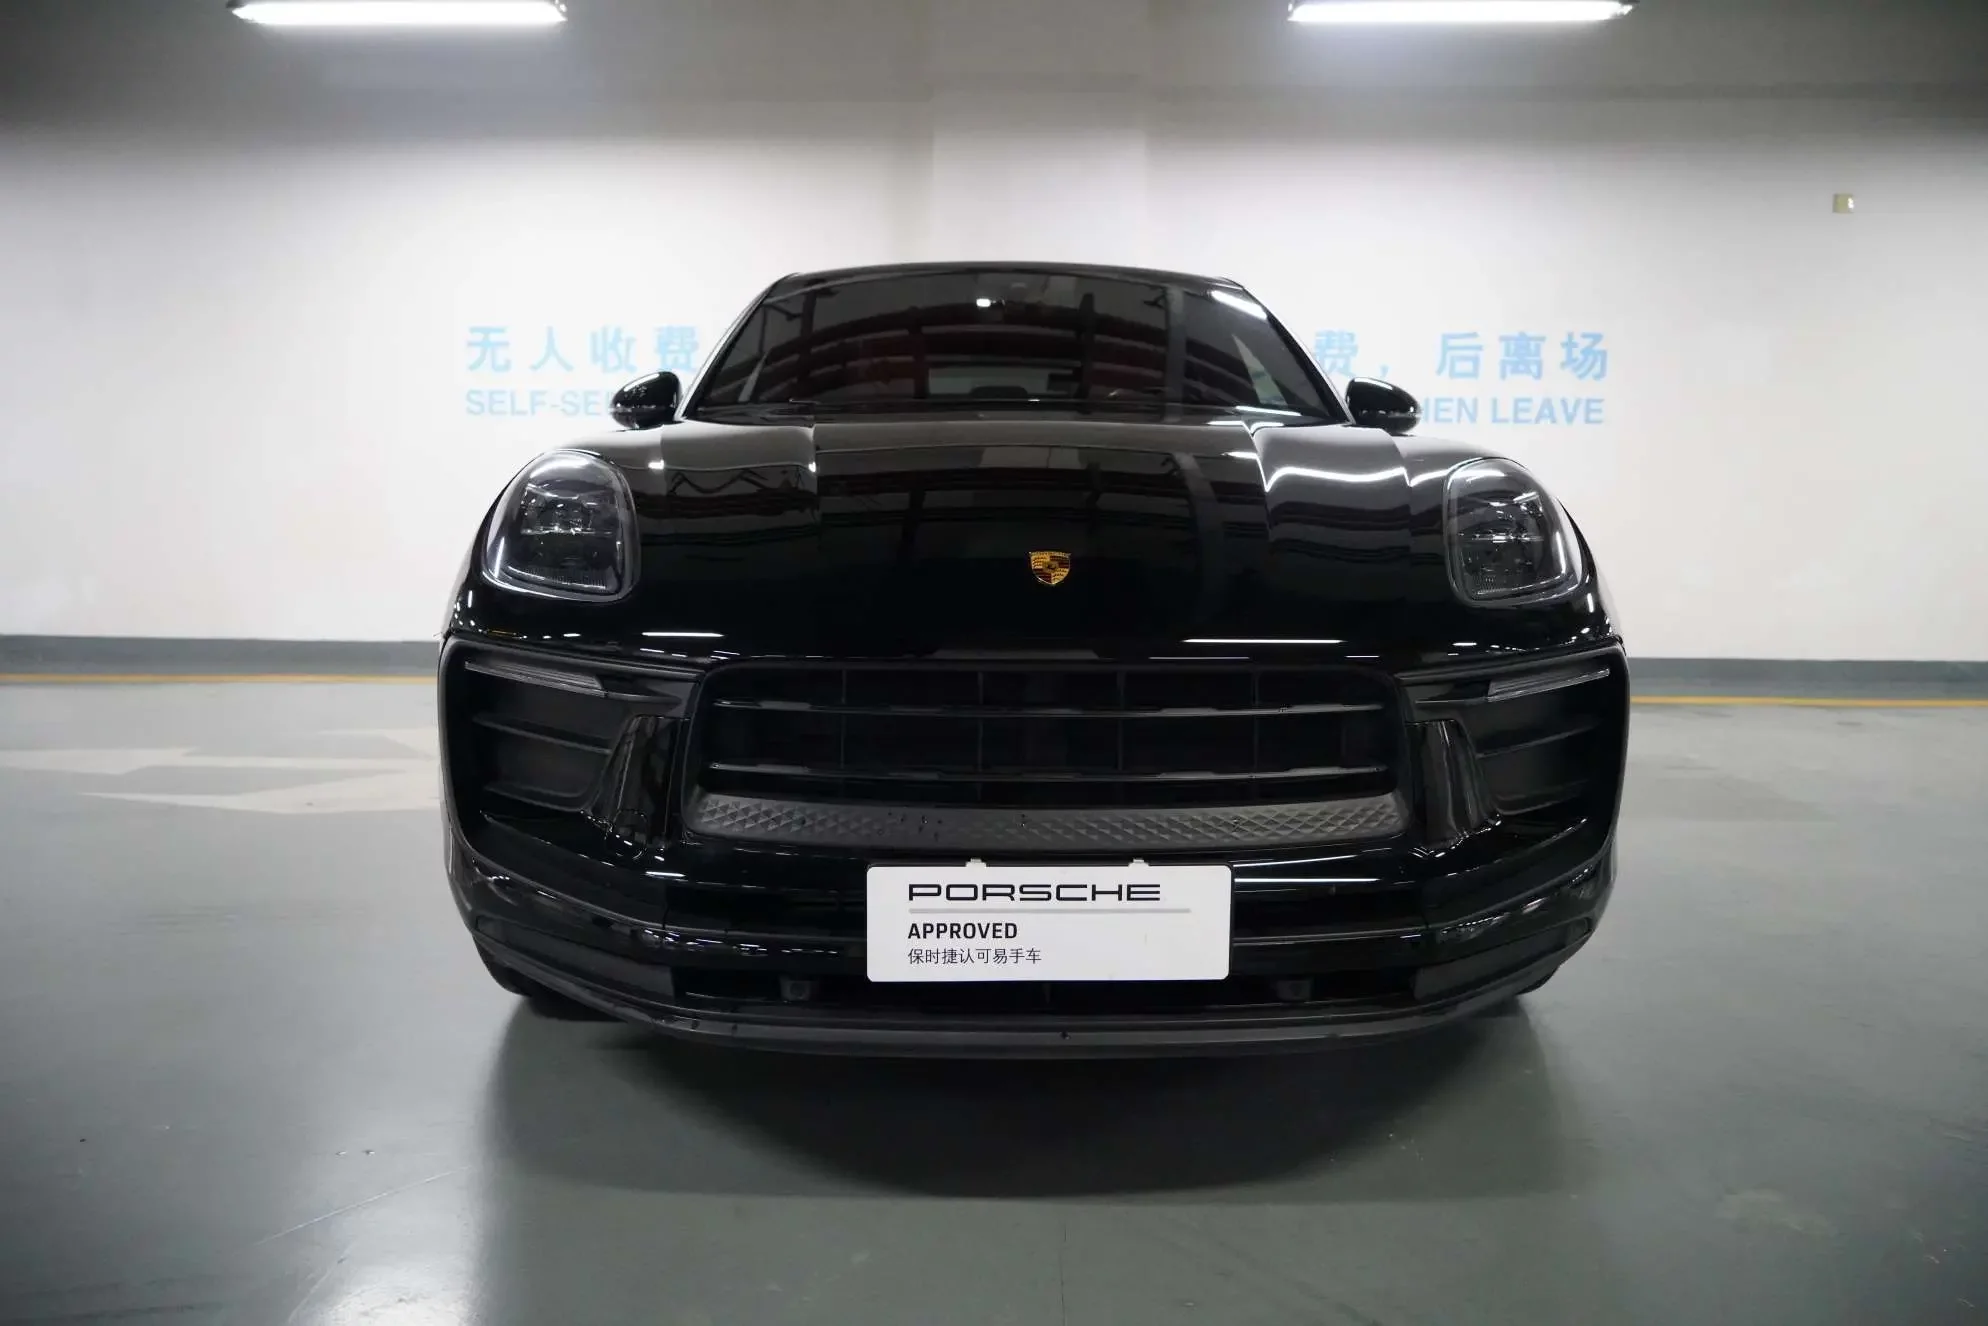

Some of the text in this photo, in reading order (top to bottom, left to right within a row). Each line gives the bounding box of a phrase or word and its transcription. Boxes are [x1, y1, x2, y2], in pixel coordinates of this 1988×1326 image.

[466, 325, 699, 373] 无人收费
[1491, 398, 1605, 424] LEAVE
[908, 884, 1161, 901] PORSCHE
[908, 923, 1018, 939] APPROVED
[907, 948, 1042, 964] 保时捷认可易手车
